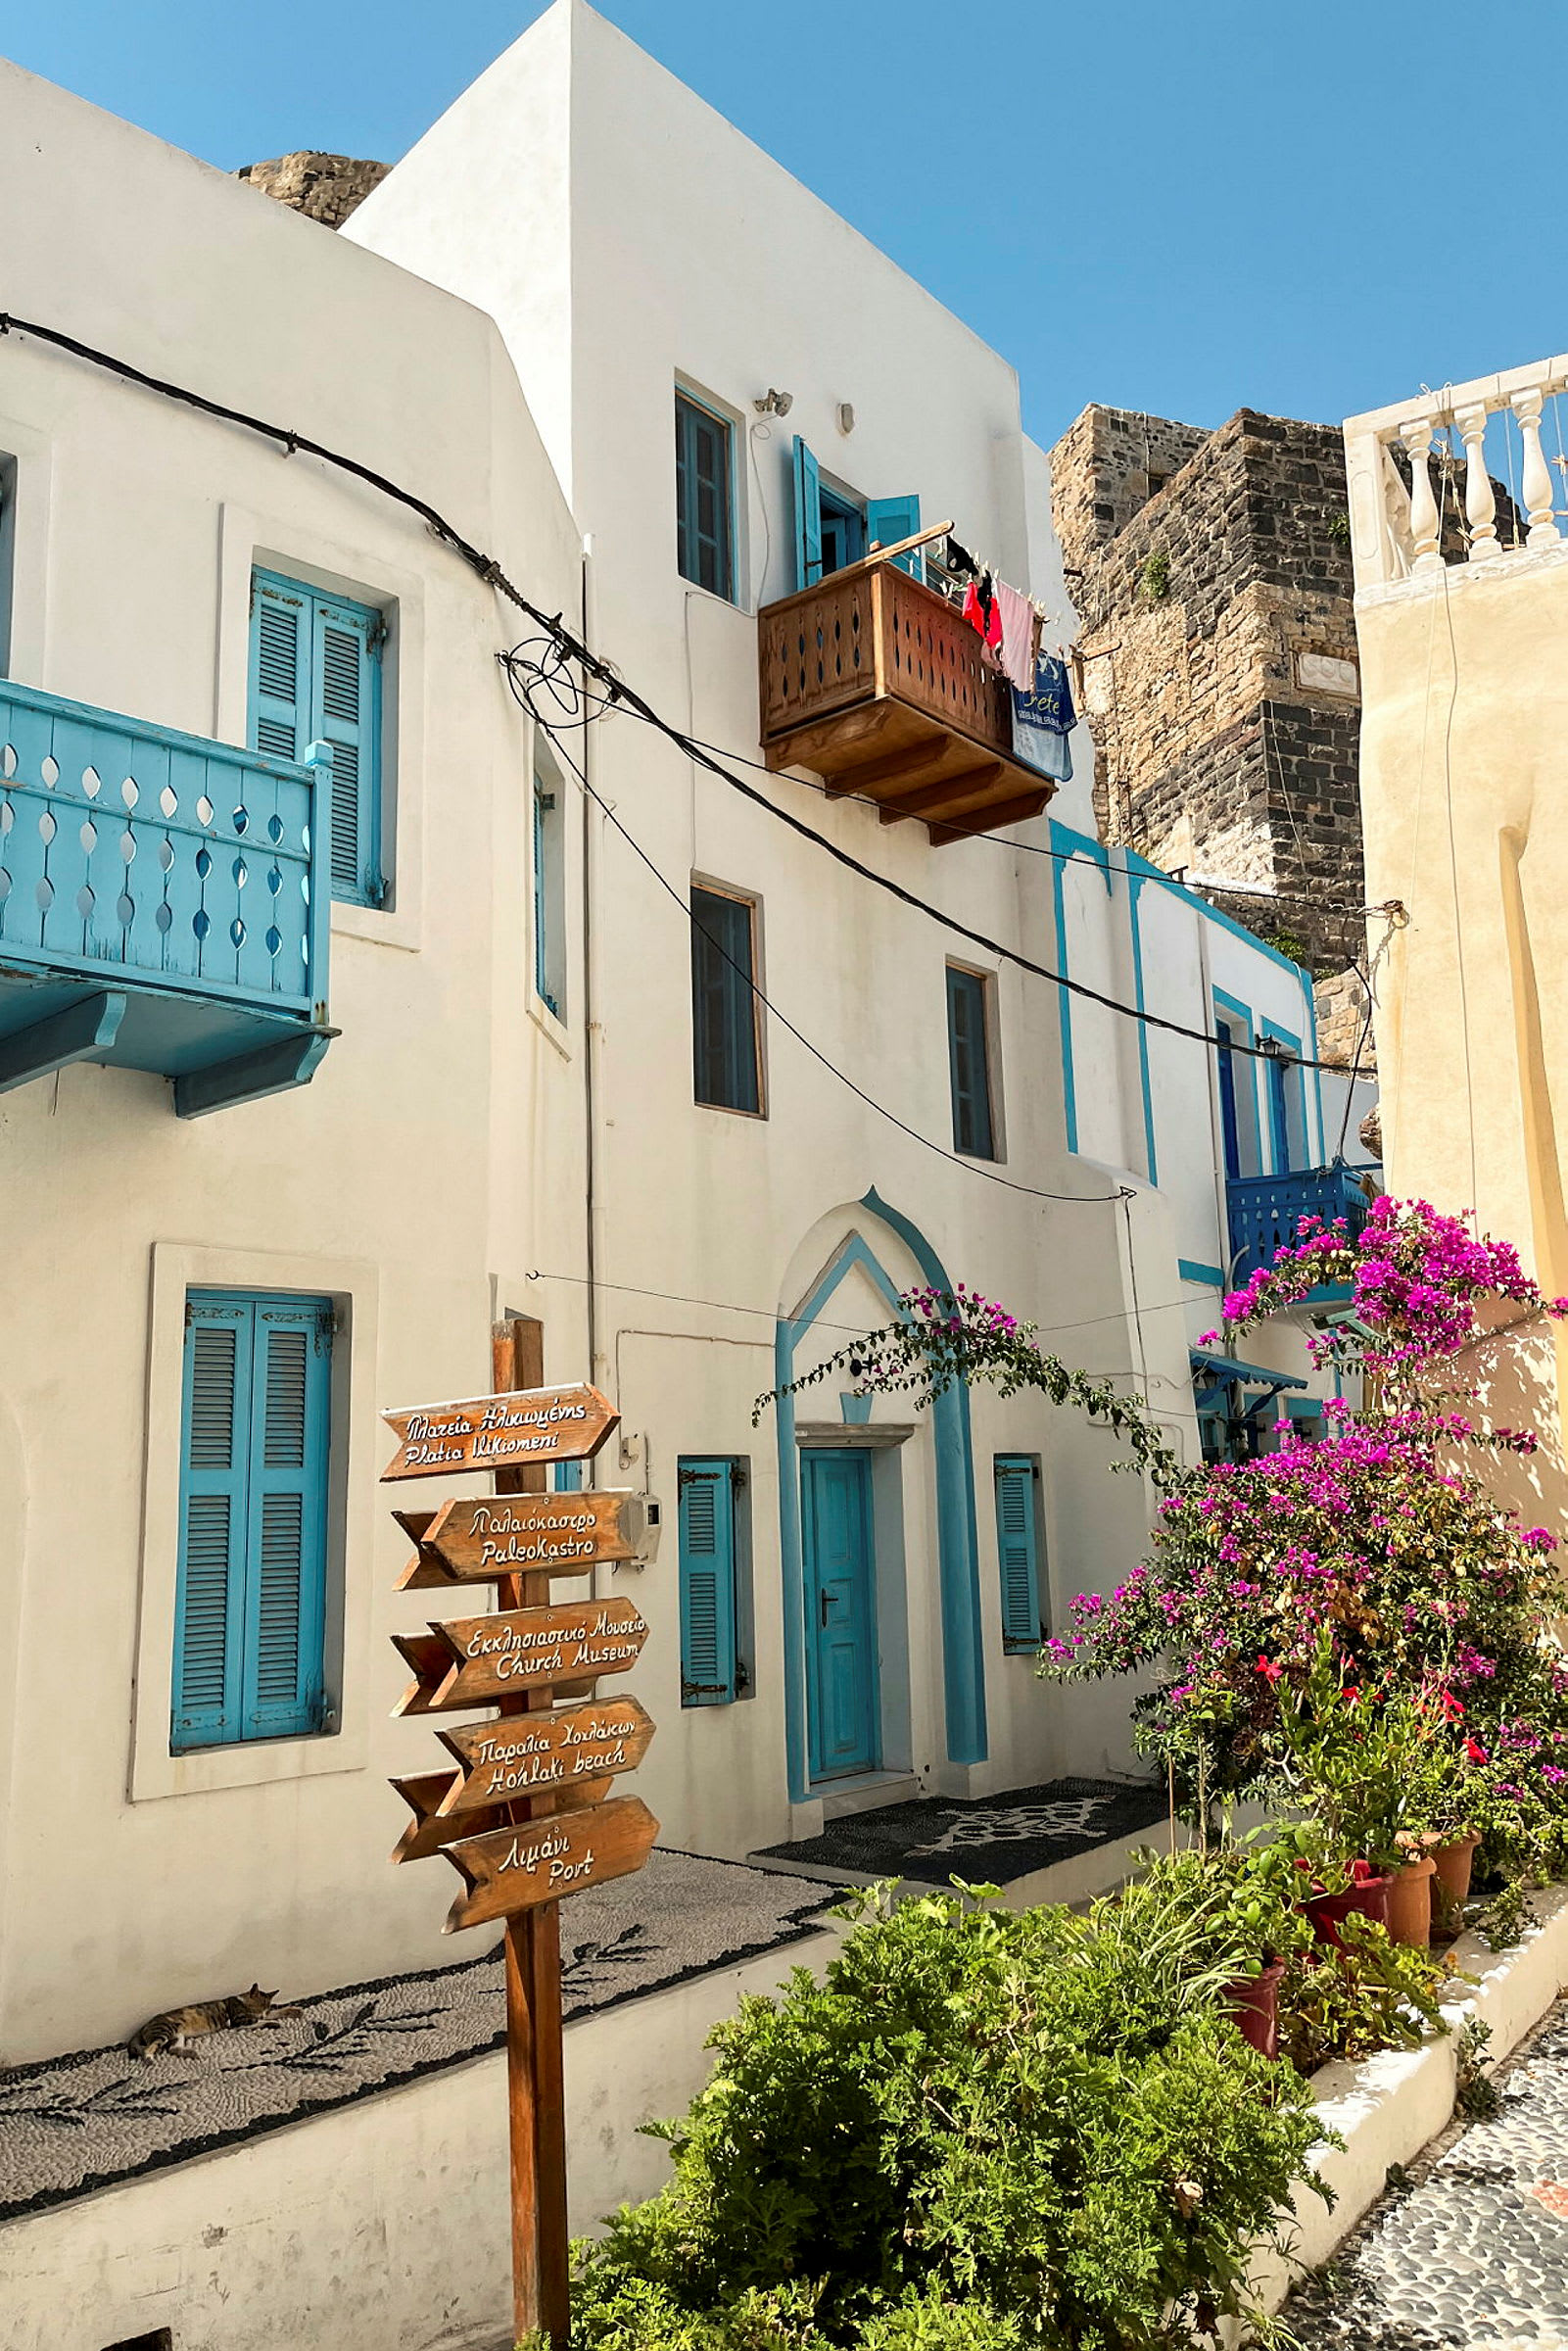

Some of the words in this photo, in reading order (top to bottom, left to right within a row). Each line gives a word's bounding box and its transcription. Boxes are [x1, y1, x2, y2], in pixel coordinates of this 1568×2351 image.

[406, 1413, 473, 1441] Πλατεία
[404, 1443, 464, 1467] Platia
[469, 1507, 596, 1537] Παλαιόκαστρο
[467, 1621, 587, 1657] Εκκλησιαστικό
[590, 1610, 646, 1638] Μουσείο
[497, 1644, 563, 1680] Church
[572, 1643, 640, 1666] Museum
[479, 1730, 550, 1765] Παραλία
[573, 1740, 627, 1774] beach
[499, 1835, 570, 1873] Λιμάνι
[548, 1849, 594, 1887] Port
